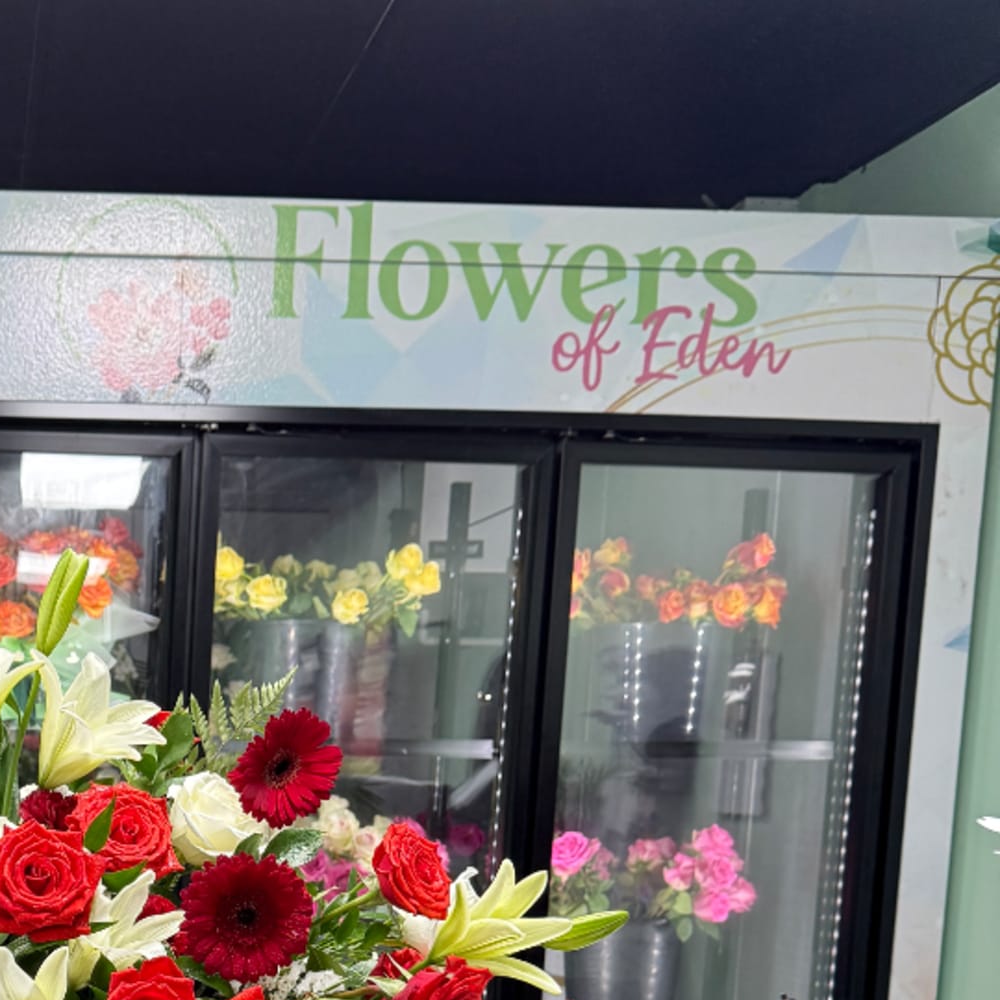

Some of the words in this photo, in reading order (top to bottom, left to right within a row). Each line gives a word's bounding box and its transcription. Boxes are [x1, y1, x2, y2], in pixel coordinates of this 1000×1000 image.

[270, 202, 758, 328] Flowers
[551, 303, 621, 392] of
[634, 302, 793, 386] Eden
